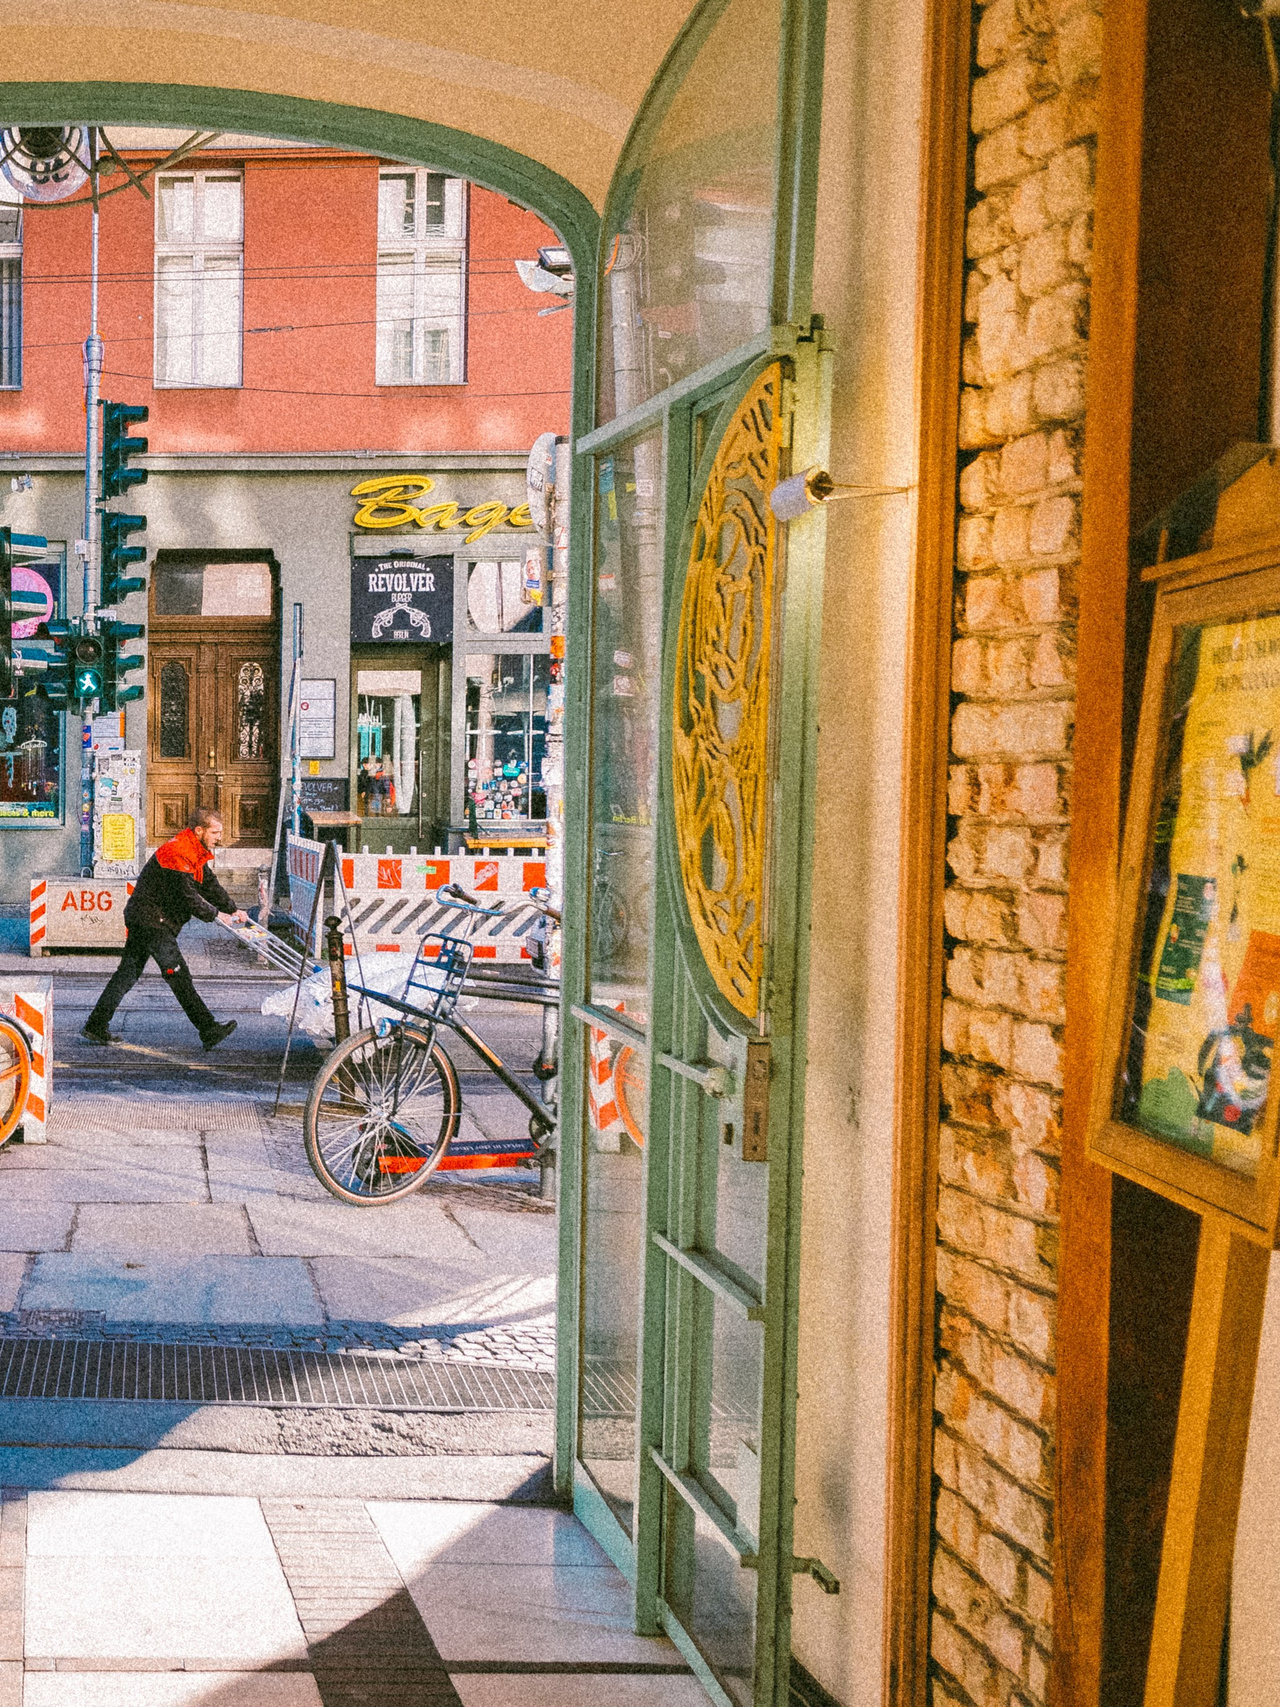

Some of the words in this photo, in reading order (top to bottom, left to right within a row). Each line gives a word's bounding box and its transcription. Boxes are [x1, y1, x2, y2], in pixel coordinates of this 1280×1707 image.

[350, 474, 534, 544] Bage
[378, 562, 393, 571] THE
[368, 572, 436, 593] REVOLVER
[391, 592, 413, 603] BURGER
[393, 630, 409, 640] BERLIN
[22, 809, 30, 818] &
[32, 810, 55, 818] more
[61, 889, 113, 911] ABG
